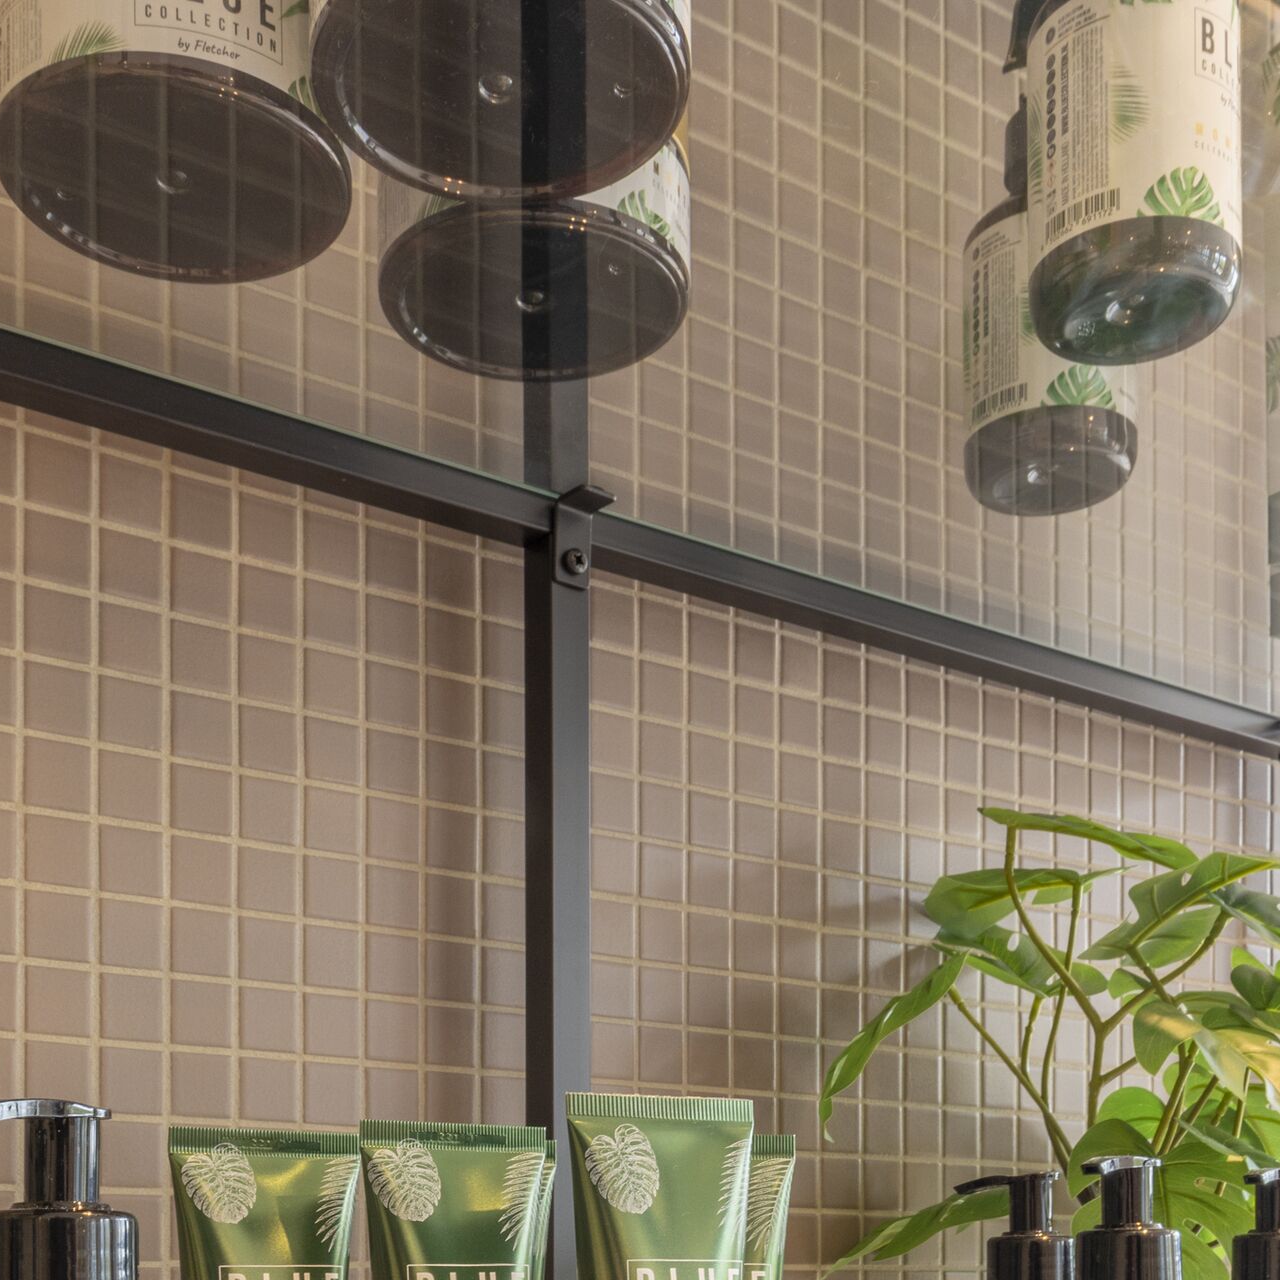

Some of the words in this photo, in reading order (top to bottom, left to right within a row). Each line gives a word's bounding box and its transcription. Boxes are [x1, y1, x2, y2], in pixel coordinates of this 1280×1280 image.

[144, 4, 277, 53] COLLECTION
[177, 37, 191, 53] by
[194, 38, 241, 60] Fletcher
[1201, 16, 1233, 69] BL
